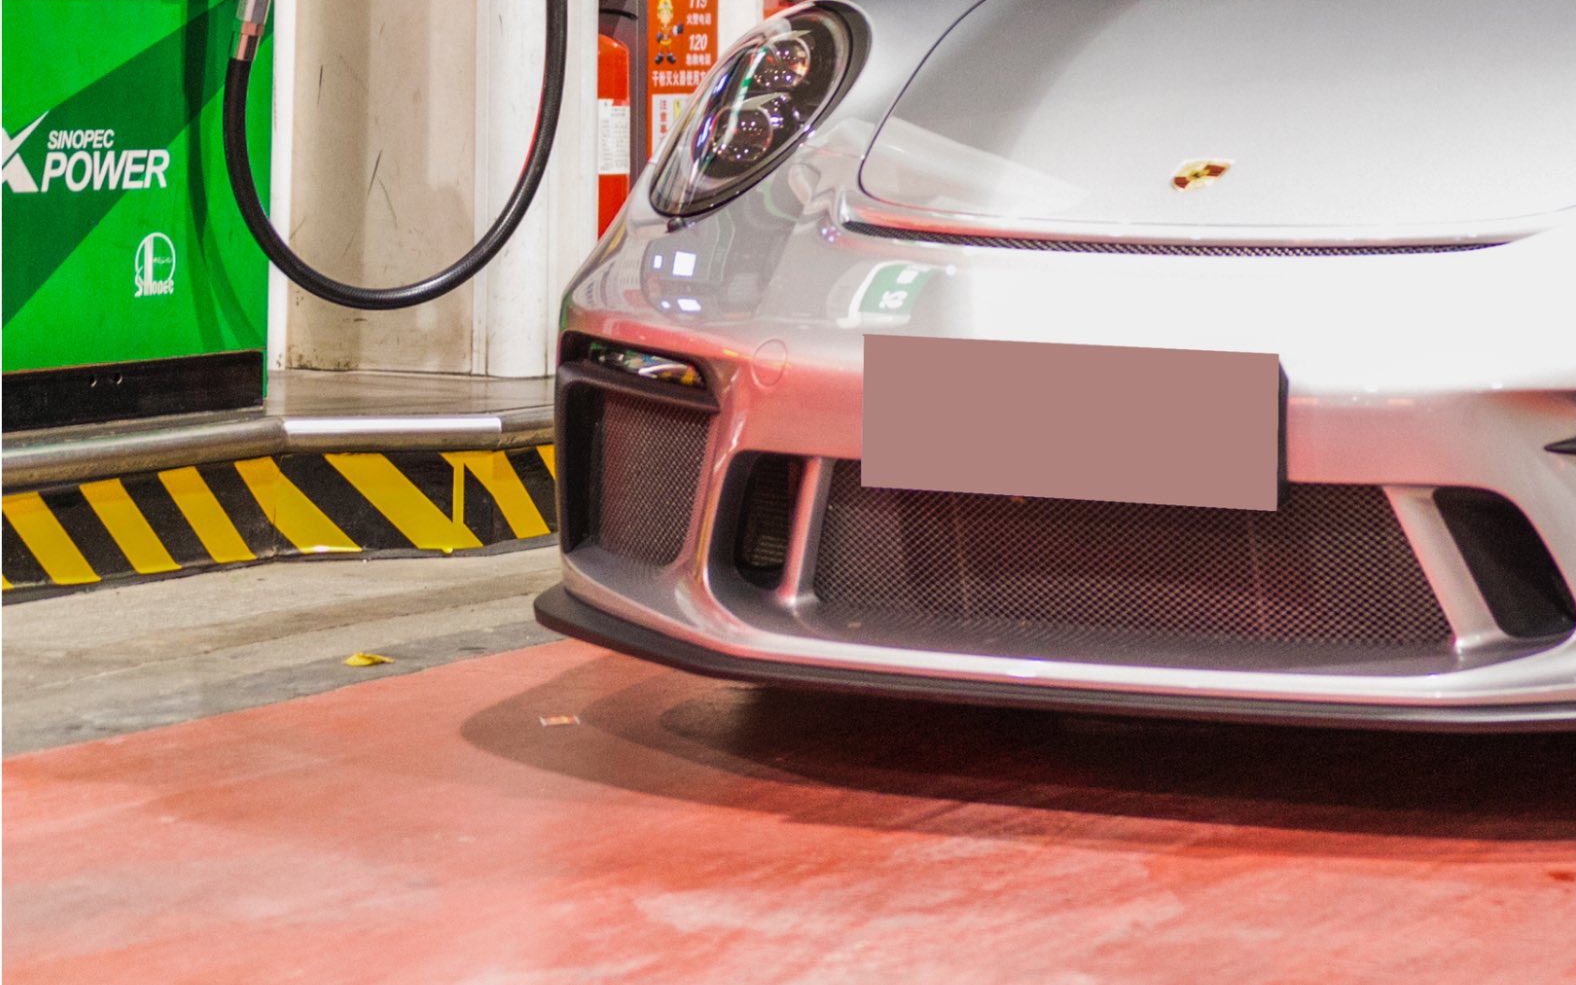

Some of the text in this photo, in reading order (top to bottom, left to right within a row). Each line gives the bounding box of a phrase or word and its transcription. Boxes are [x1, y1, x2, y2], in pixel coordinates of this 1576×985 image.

[689, 34, 708, 52] 120
[47, 128, 115, 150] SINOPEC
[41, 148, 171, 194] POWER
